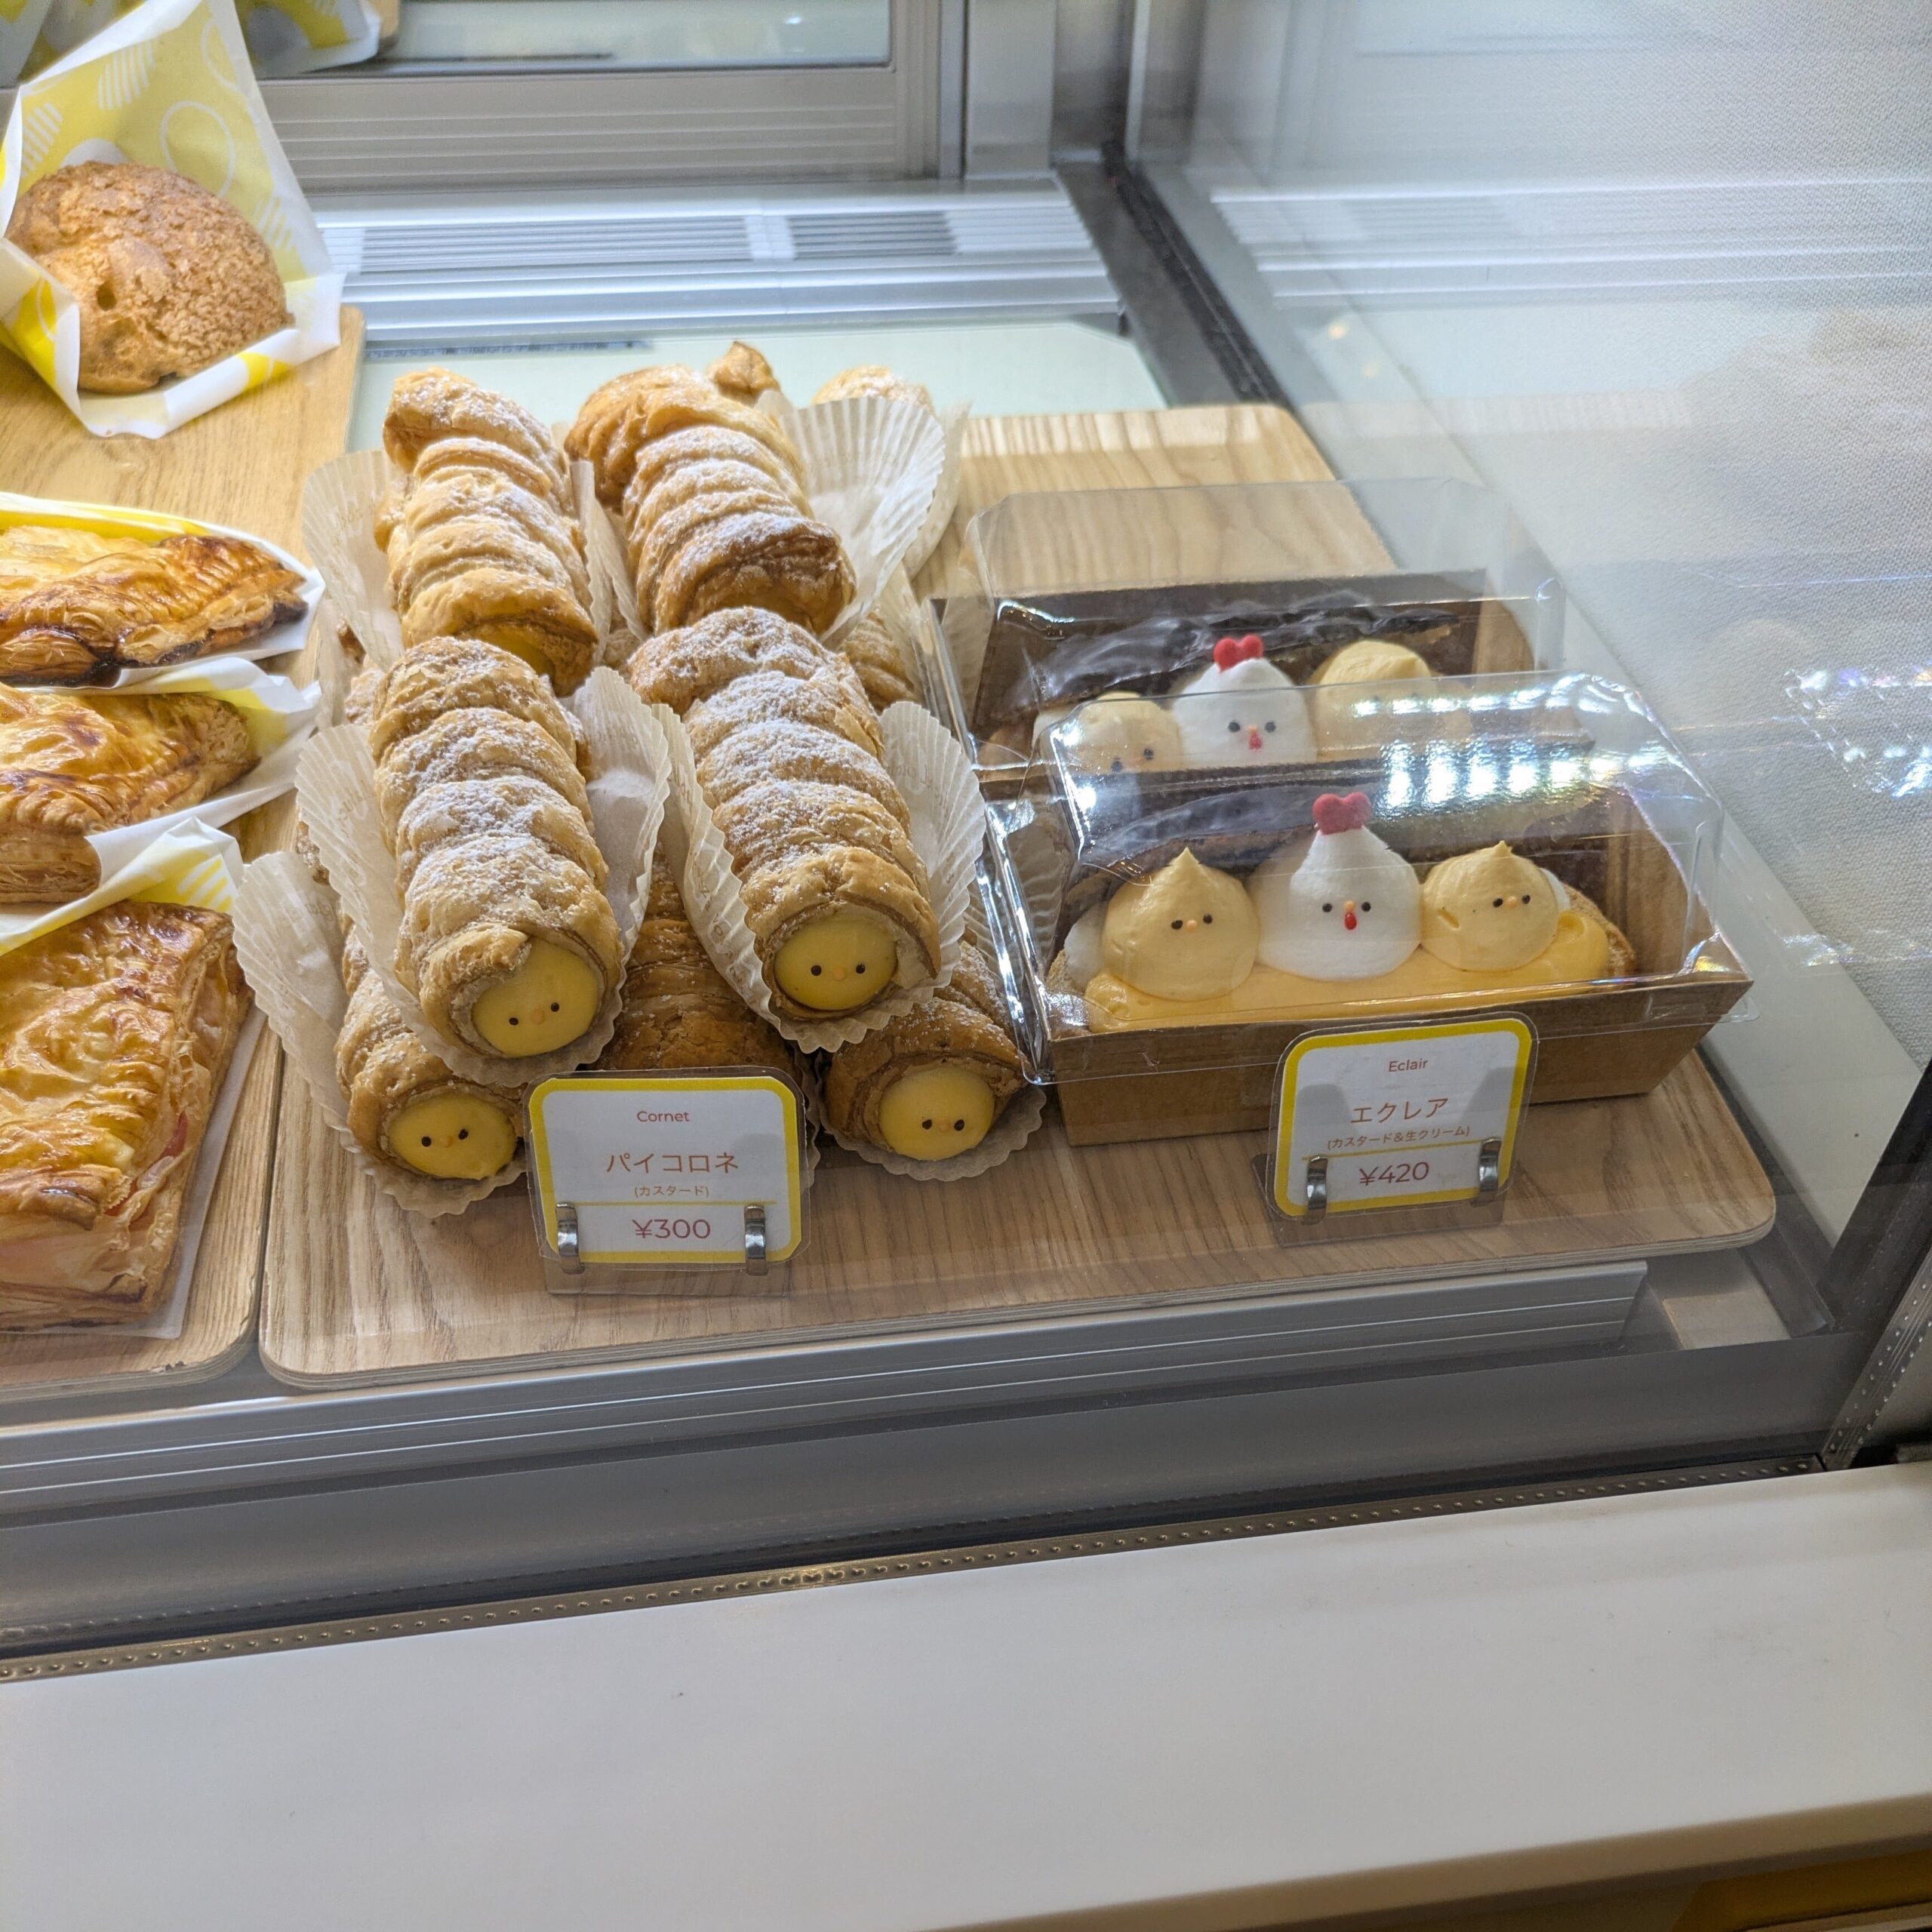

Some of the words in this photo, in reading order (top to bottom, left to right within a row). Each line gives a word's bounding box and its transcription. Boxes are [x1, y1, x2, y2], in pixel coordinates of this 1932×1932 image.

[1388, 1059, 1428, 1072] Eclair
[636, 1111, 690, 1122] Cornet
[1350, 1098, 1448, 1123] エクレア
[606, 1152, 738, 1173] パイコロネ
[1358, 1162, 1429, 1186] ¥420
[635, 1186, 709, 1198] (カスタード)
[632, 1220, 710, 1238] ¥300
